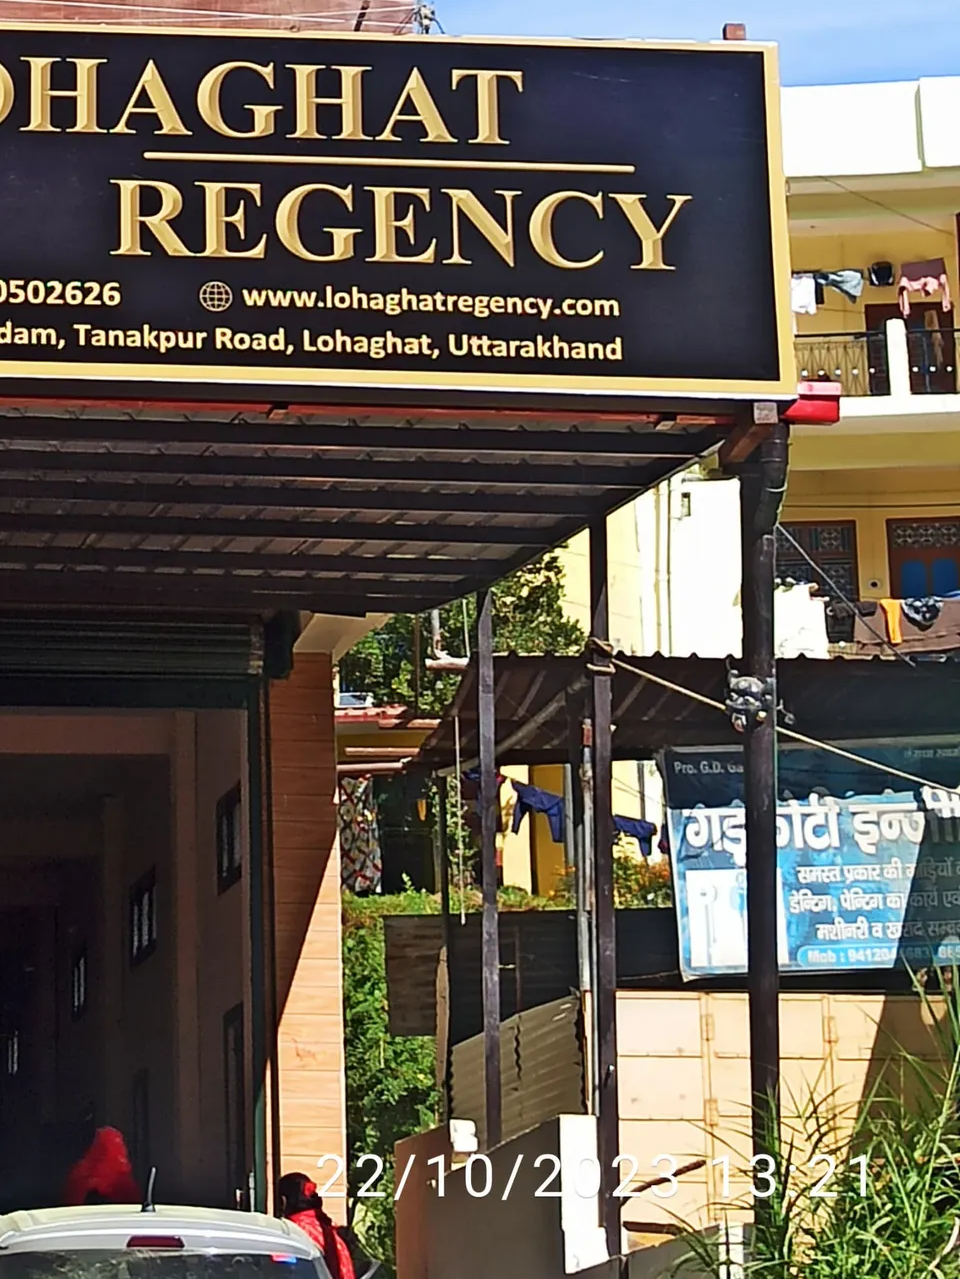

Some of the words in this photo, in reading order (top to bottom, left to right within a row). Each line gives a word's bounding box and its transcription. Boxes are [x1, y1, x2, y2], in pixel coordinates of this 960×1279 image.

[109, 178, 693, 271] REGENCY
[242, 286, 620, 320] www.lohaghatregency.com
[73, 324, 208, 354] Tanakpur
[215, 327, 295, 356] Road,
[303, 329, 440, 359] Lohaghat,
[448, 333, 623, 361] Uttarakhand
[700, 760, 726, 774] G.D.
